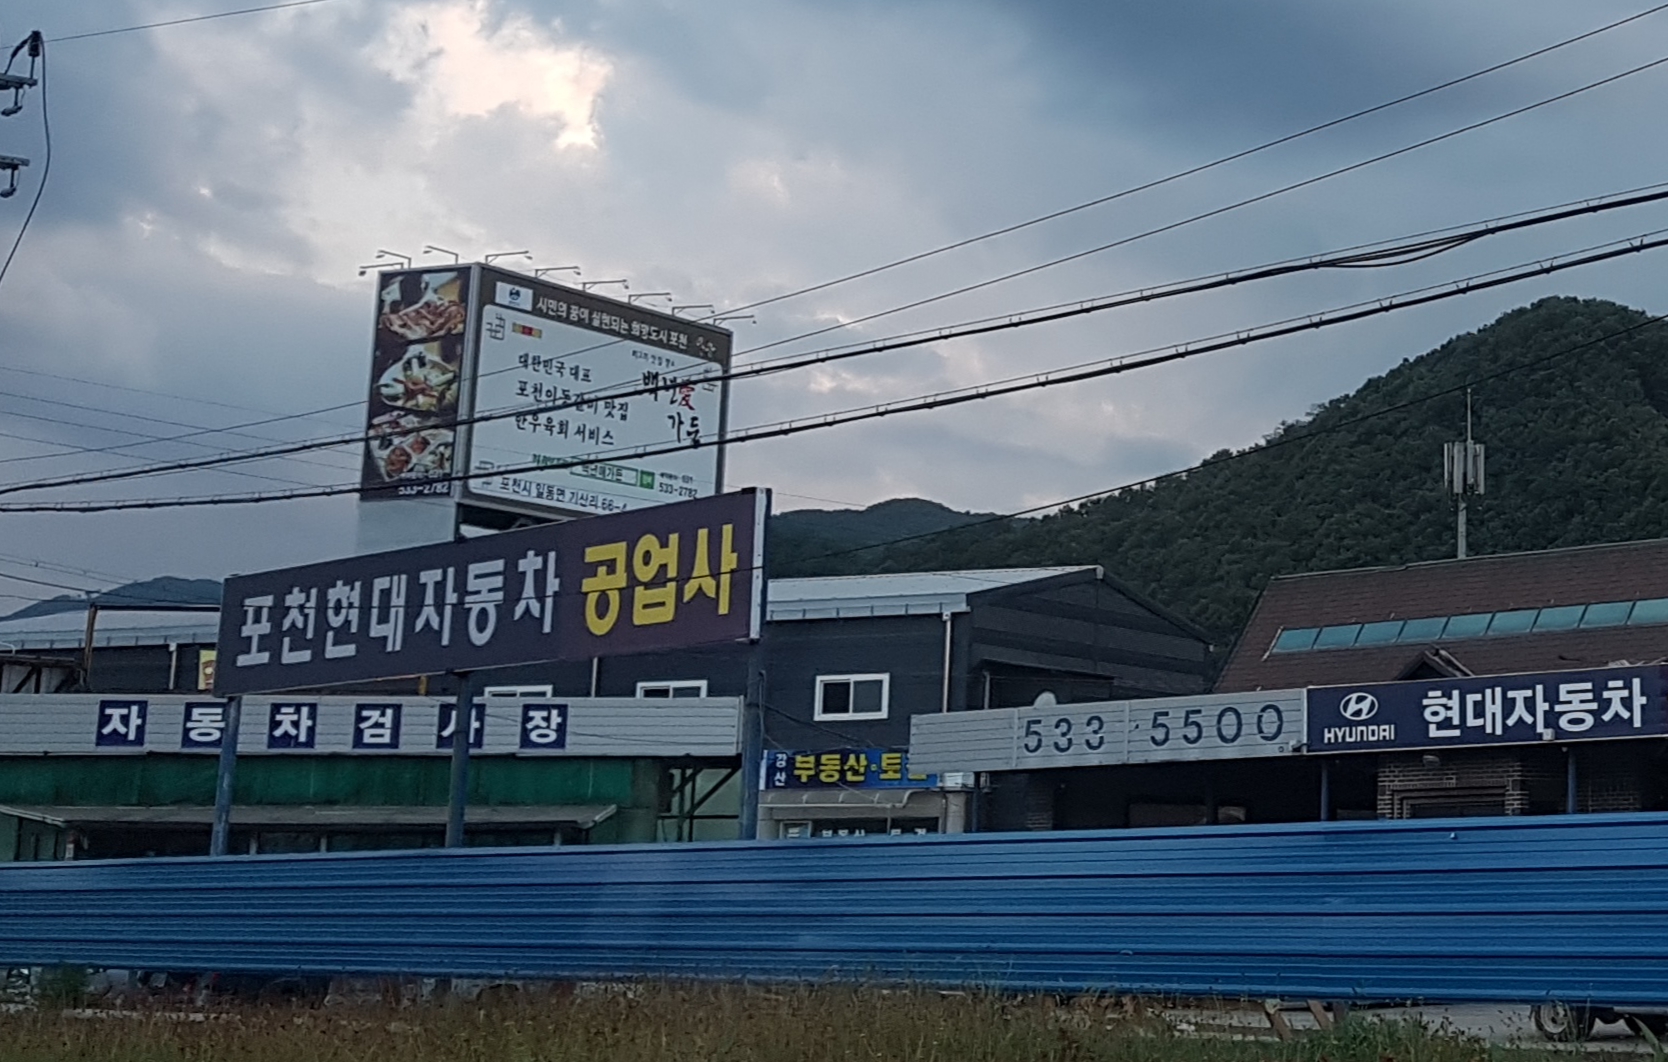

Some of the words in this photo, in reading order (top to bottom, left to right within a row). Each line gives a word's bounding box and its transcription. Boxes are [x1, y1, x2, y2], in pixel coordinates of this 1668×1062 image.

[536, 296, 567, 318] 시민의
[518, 353, 567, 376] 대한민국
[569, 364, 593, 383] 대표
[604, 401, 629, 421] 맛집
[574, 424, 614, 445] 서비스
[500, 477, 531, 496] 포천시
[535, 484, 566, 502] 일동면
[569, 491, 598, 509] 기산리
[236, 550, 561, 668] 포천현대자동차
[580, 522, 739, 636] 공업사
[1150, 704, 1285, 746] 5500
[1323, 725, 1395, 744] HYUNDAI
[1422, 678, 1647, 739] 현대자동차
